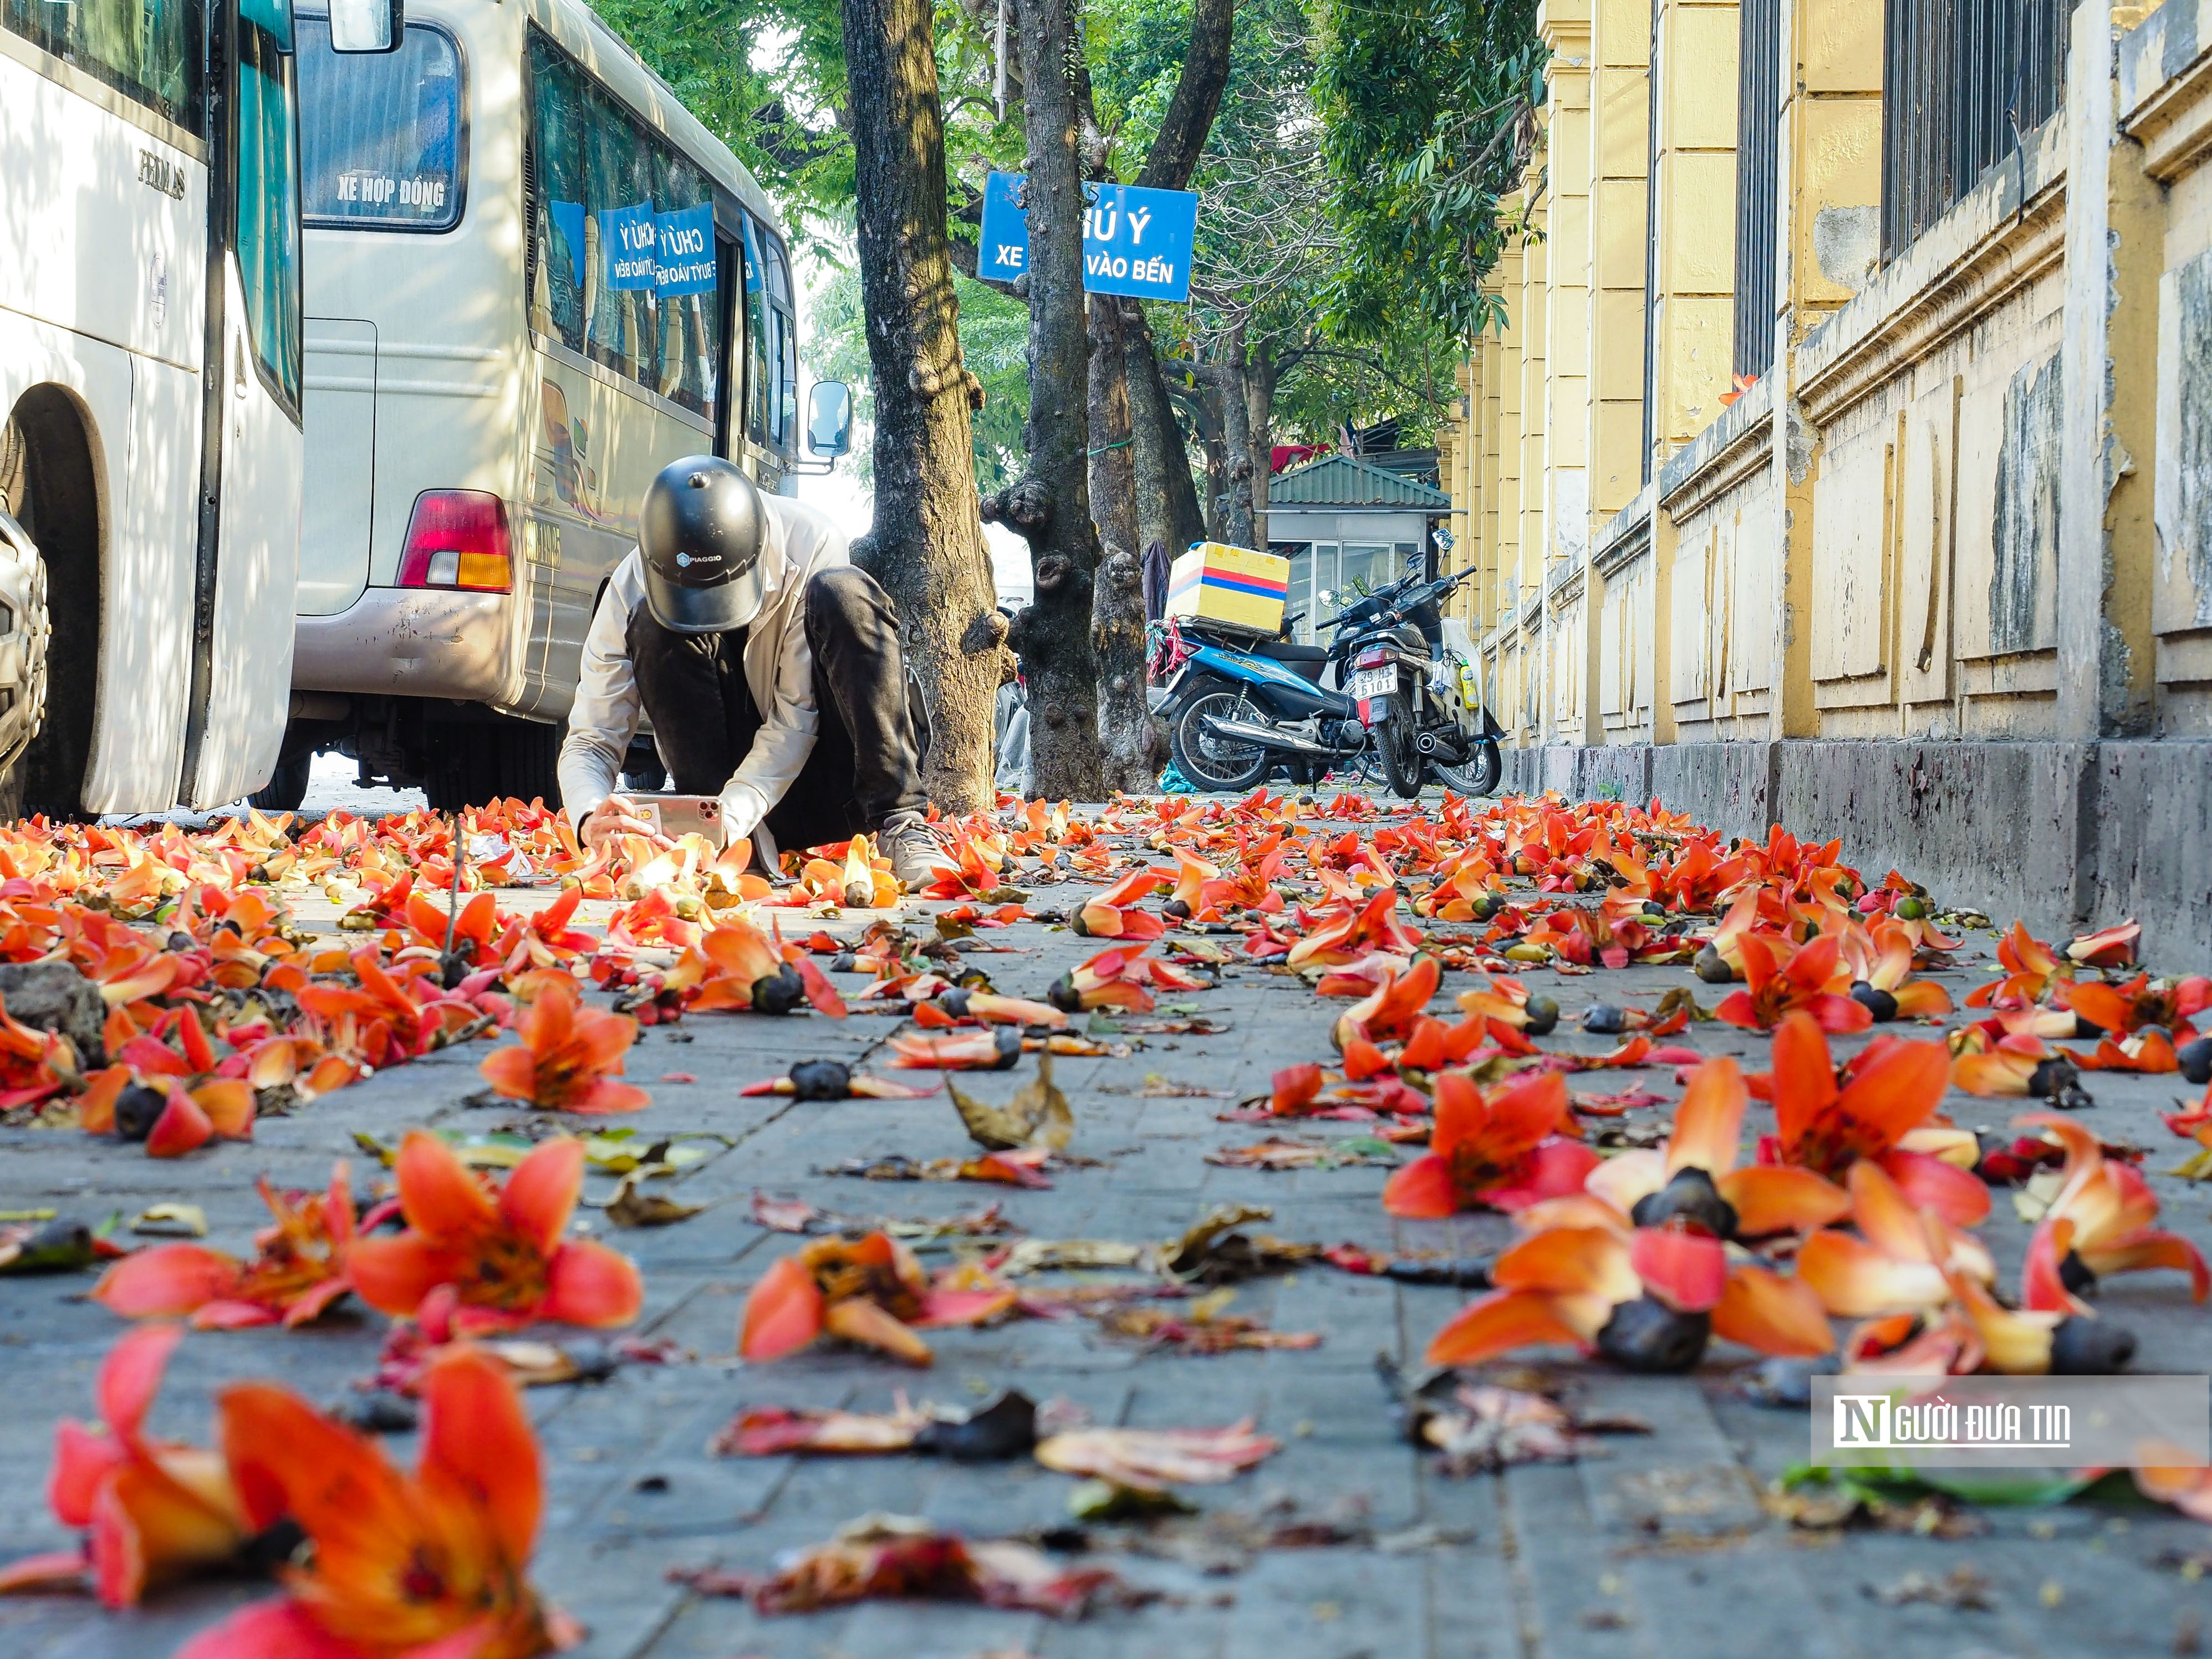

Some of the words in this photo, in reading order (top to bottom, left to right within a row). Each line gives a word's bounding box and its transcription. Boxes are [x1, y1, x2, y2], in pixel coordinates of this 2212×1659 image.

[337, 176, 358, 201] XE
[361, 175, 395, 207] HỢP
[399, 175, 444, 207] ĐỒNG
[1128, 206, 1152, 244] Ý
[995, 244, 1024, 267] XE
[1086, 251, 1128, 278] VÀO
[1132, 255, 1174, 284] BẾN
[1361, 679, 1390, 696] 6101
